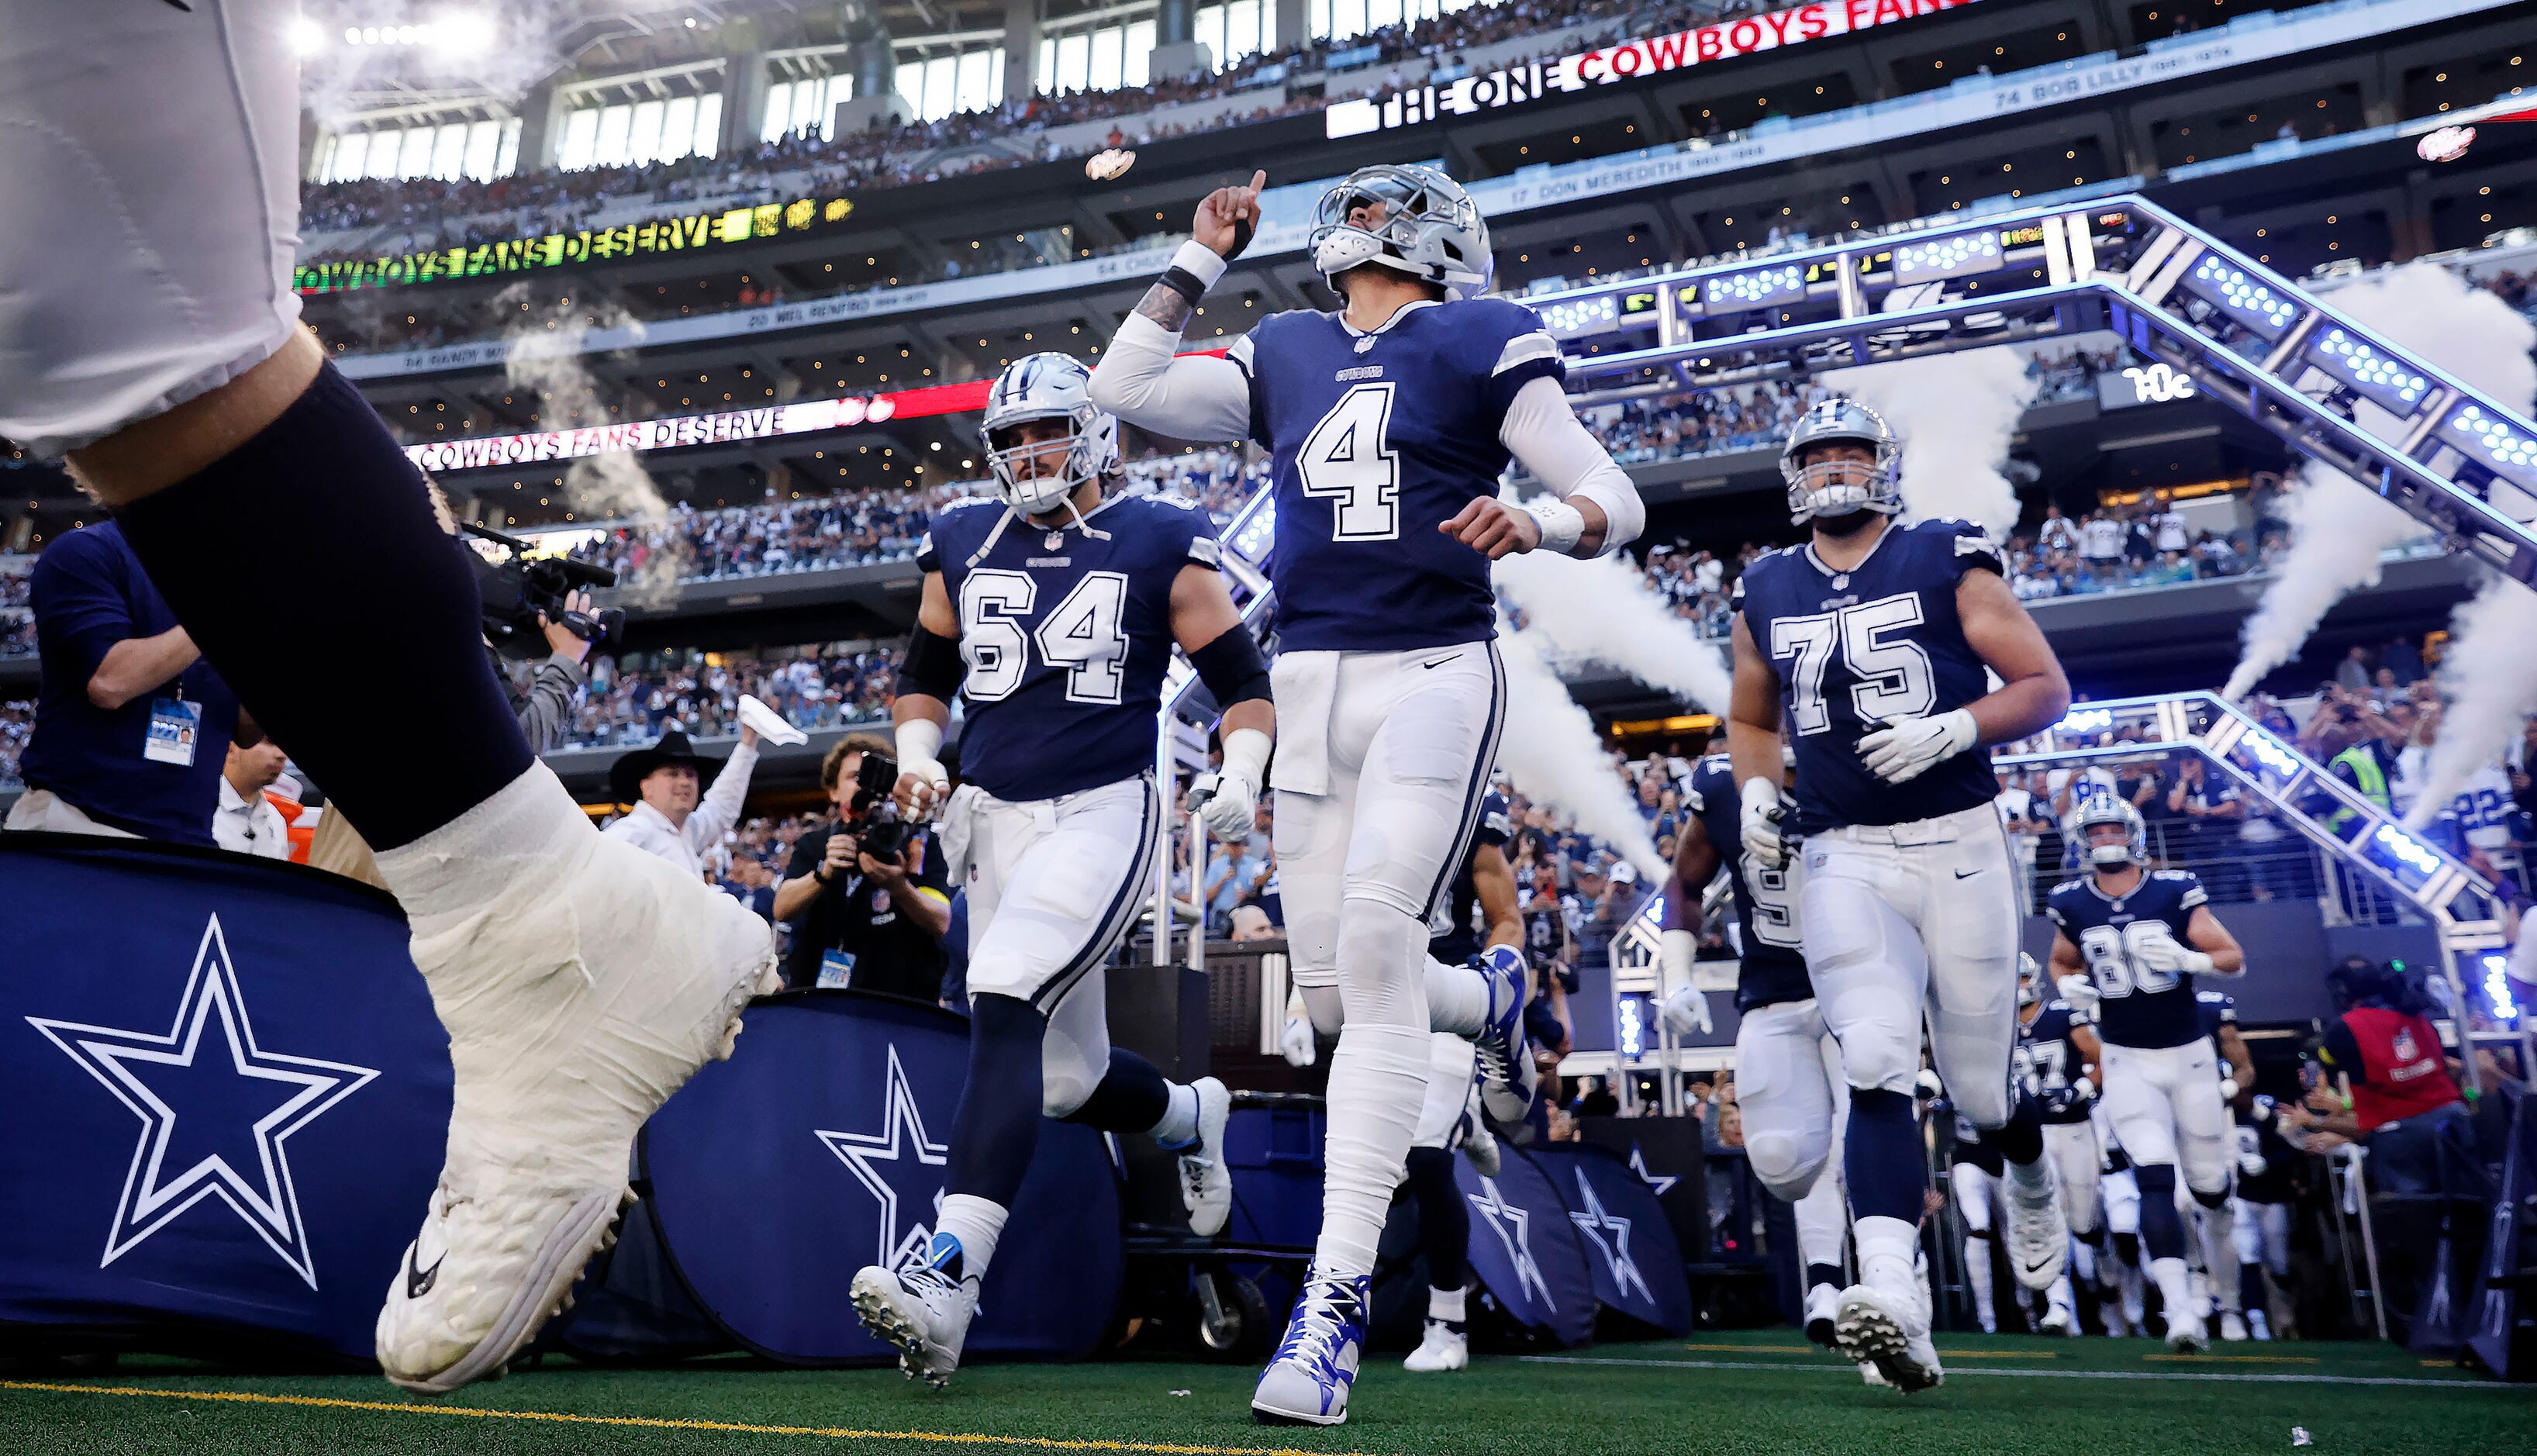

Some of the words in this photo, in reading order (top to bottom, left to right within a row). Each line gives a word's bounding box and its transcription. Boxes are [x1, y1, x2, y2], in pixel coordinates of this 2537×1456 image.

[1370, 82, 1455, 129] THE
[1470, 59, 1562, 110] ONE
[1577, 5, 1829, 80] COWBOYS
[1846, 0, 1970, 31] FAN
[1586, 160, 1683, 190] MEREDITH
[293, 248, 451, 293] OWBOYS
[464, 236, 546, 278] FANS
[563, 212, 727, 264] DESERVE
[420, 430, 560, 467] COWBOYS
[572, 422, 642, 452] FANS
[654, 405, 786, 447] DESERVE
[1295, 381, 1400, 543] 4
[958, 568, 1129, 706] 64
[1770, 591, 1937, 737] 75
